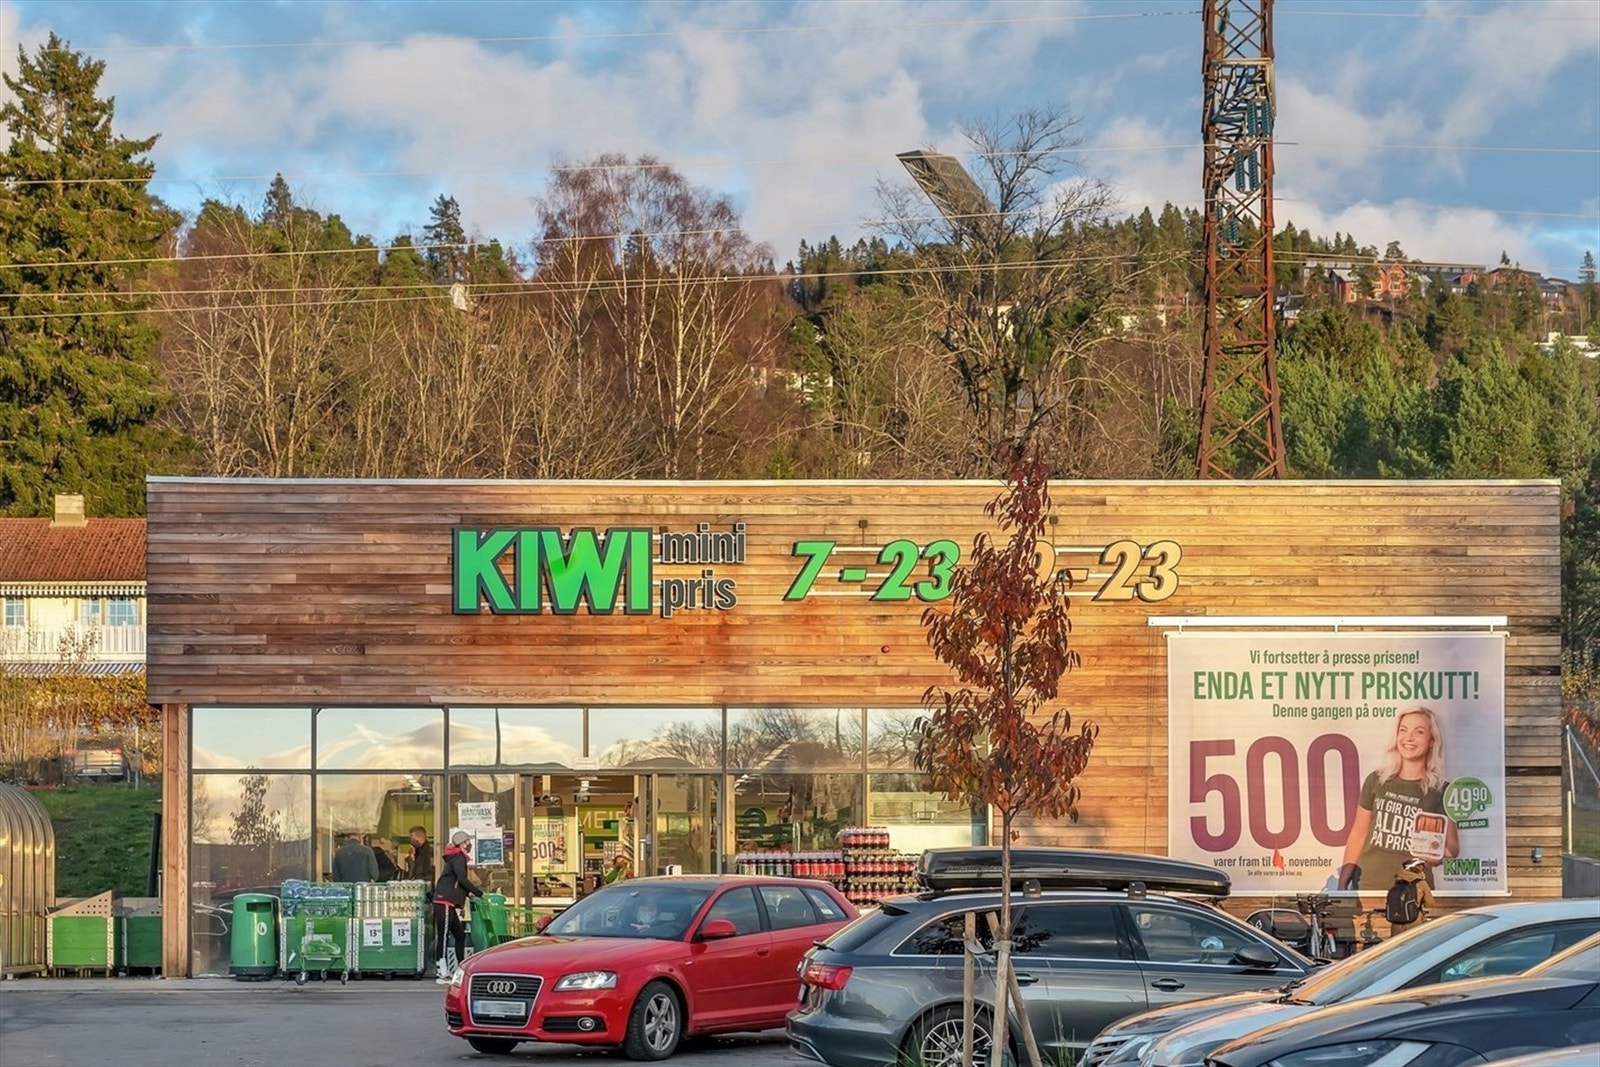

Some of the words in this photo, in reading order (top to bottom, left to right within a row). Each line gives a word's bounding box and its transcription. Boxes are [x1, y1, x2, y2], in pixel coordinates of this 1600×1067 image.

[661, 522, 746, 564] mini
[452, 527, 653, 615] KIWI
[661, 569, 738, 618] pris
[1250, 650, 1261, 664] Vi
[1263, 650, 1319, 664] fortsetter
[1323, 649, 1330, 664] å
[1332, 653, 1370, 667] presse
[1373, 650, 1420, 667] prisene!
[1193, 671, 1254, 700] ENDA
[1261, 671, 1288, 700] ET
[1295, 671, 1354, 700] NYTT
[1361, 671, 1480, 700] PRISKUTT!
[1273, 704, 1308, 718] Denne
[1311, 707, 1353, 720] gangen
[1355, 704, 1369, 720] på
[1373, 707, 1398, 718] over
[1189, 733, 1361, 852] 500
[1385, 800, 1402, 815] GIR
[1385, 834, 1412, 852] PRIS
[1213, 858, 1236, 867] varer
[1239, 856, 1260, 867] fram
[1262, 856, 1271, 867] til
[1288, 856, 1332, 867] november
[1443, 858, 1480, 875] KIWI
[1481, 867, 1497, 877] pris
